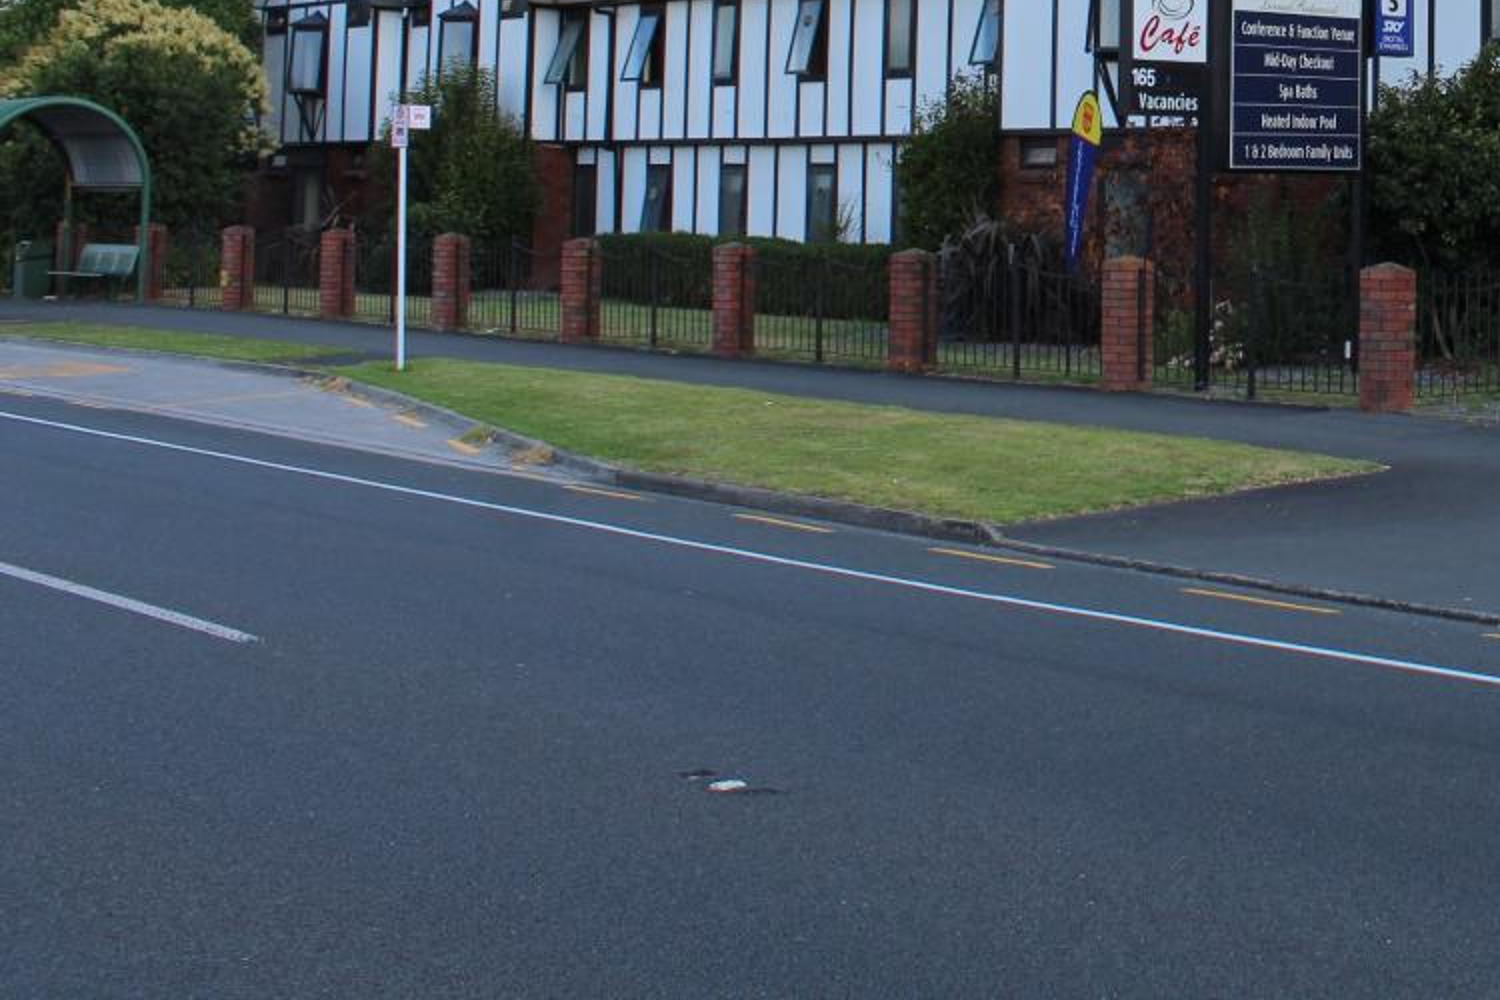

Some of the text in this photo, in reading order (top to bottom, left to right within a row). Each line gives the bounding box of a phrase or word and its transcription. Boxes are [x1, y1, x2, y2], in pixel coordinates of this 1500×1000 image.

[1140, 15, 1201, 54] Café
[1241, 20, 1287, 38] Conference
[1297, 24, 1329, 40] Function
[1263, 52, 1335, 71] Mid-Day Checkout
[1131, 67, 1156, 87] 165
[1138, 92, 1199, 111] Vacancies
[1279, 83, 1294, 101] Spa
[1261, 113, 1337, 129] Heated Indoor Pool
[1267, 144, 1304, 159] Bedroom
[1305, 143, 1332, 162] Family
